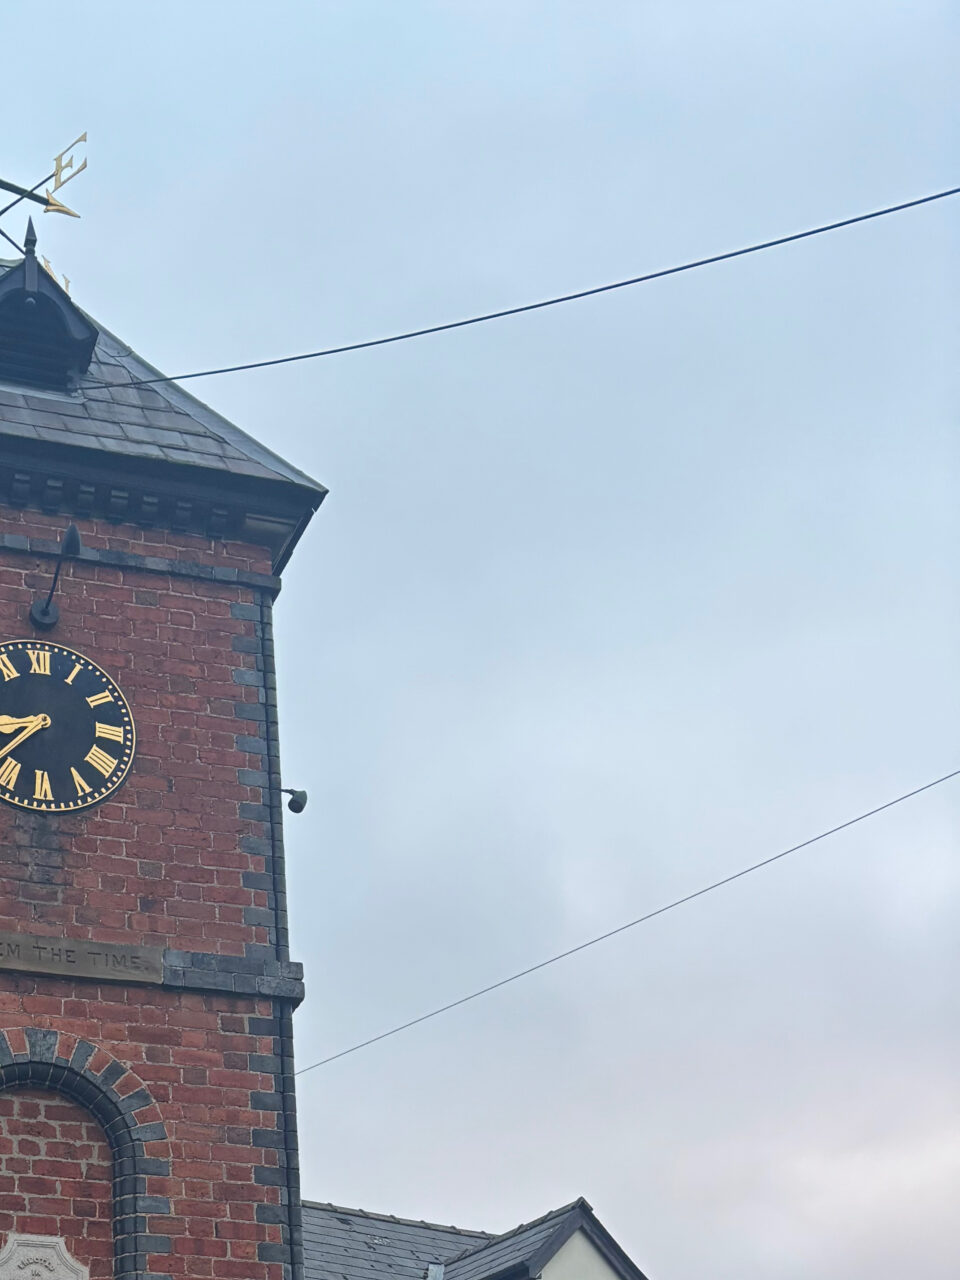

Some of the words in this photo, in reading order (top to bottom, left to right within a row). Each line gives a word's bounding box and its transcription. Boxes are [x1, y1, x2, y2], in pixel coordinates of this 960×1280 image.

[53, 131, 87, 193] E
[26, 649, 52, 676] XII
[64, 662, 83, 685] I
[86, 690, 114, 708] II
[95, 721, 124, 744] III
[84, 744, 118, 779] IIII
[33, 770, 54, 801] VI
[70, 767, 93, 797] V
[33, 943, 76, 964] THE
[17, 1256, 56, 1272] ERECTED
